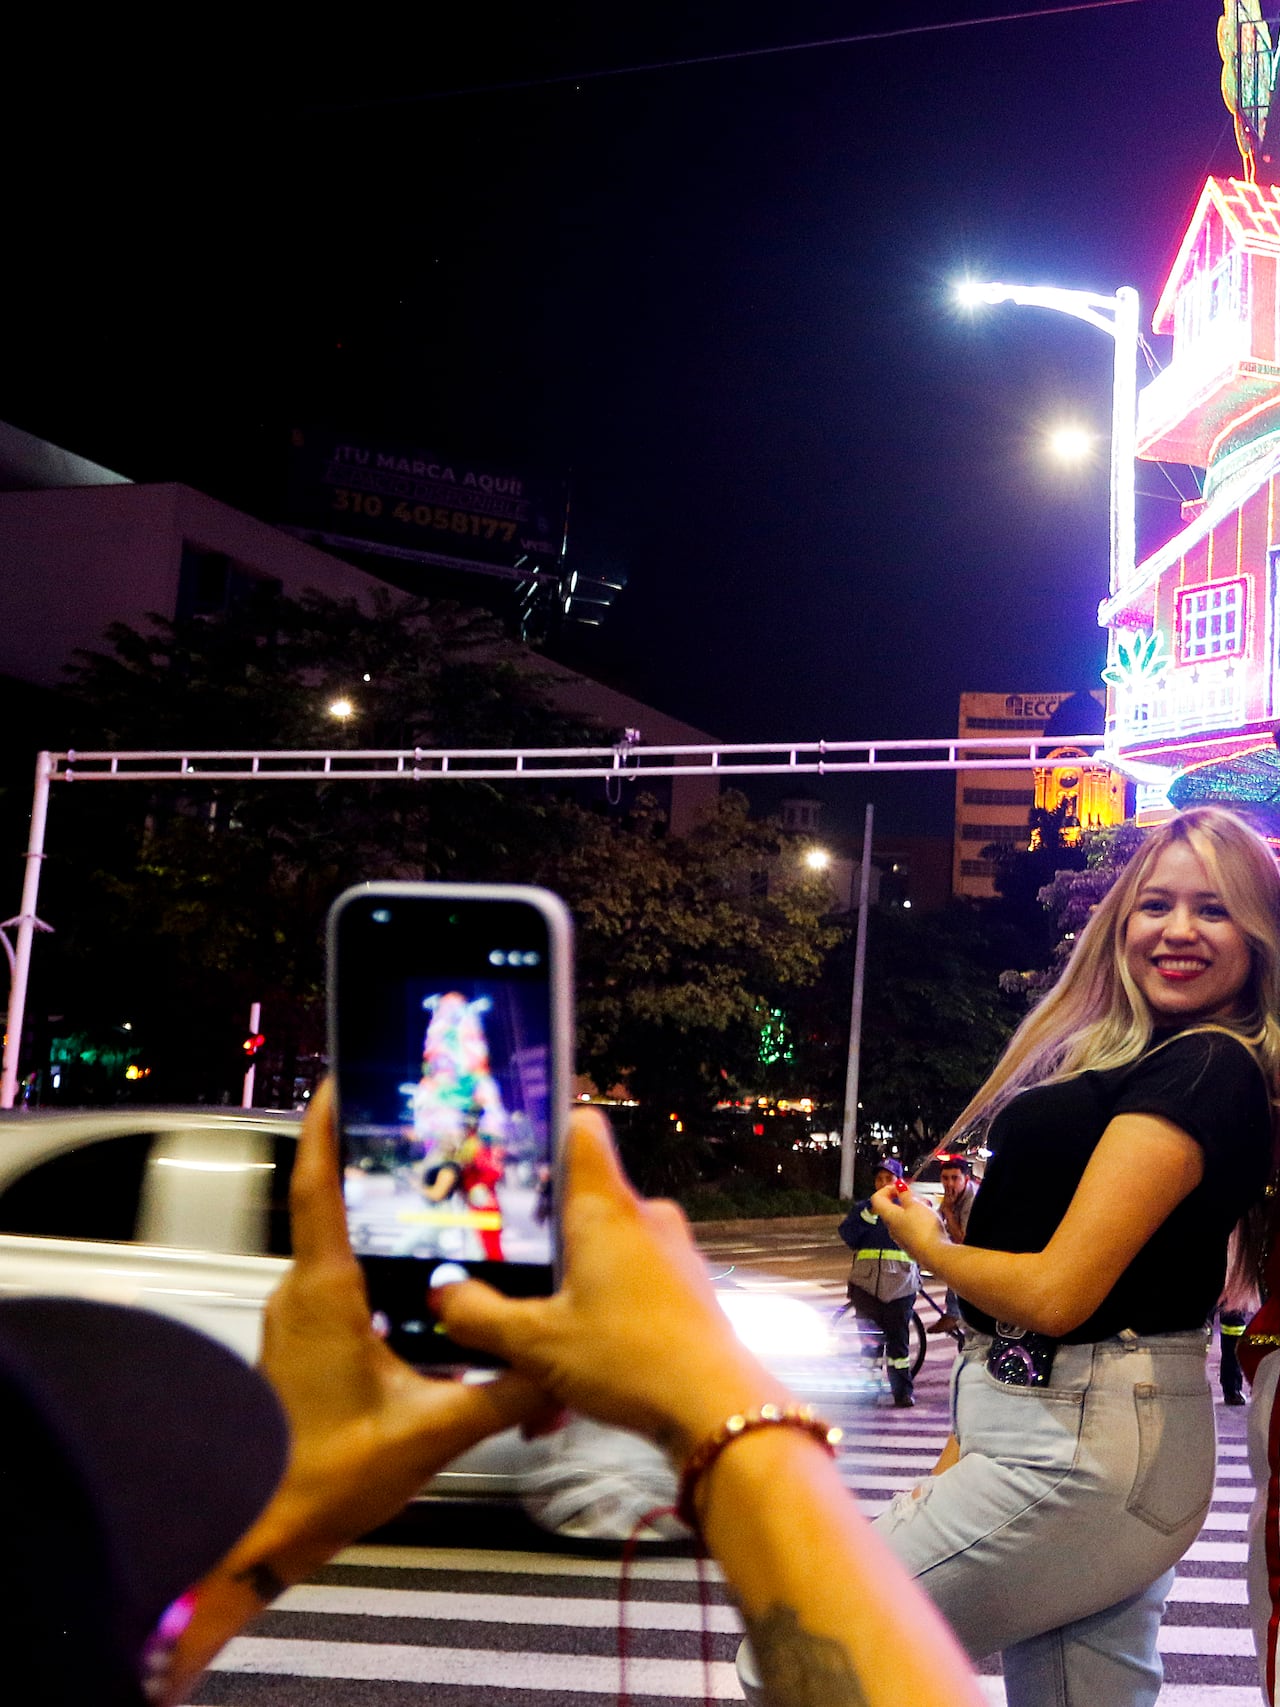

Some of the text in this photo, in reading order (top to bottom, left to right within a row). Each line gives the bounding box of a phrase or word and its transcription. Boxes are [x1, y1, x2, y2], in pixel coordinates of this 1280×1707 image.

[376, 452, 456, 483] MARCA
[331, 488, 518, 543] 310 4058177
